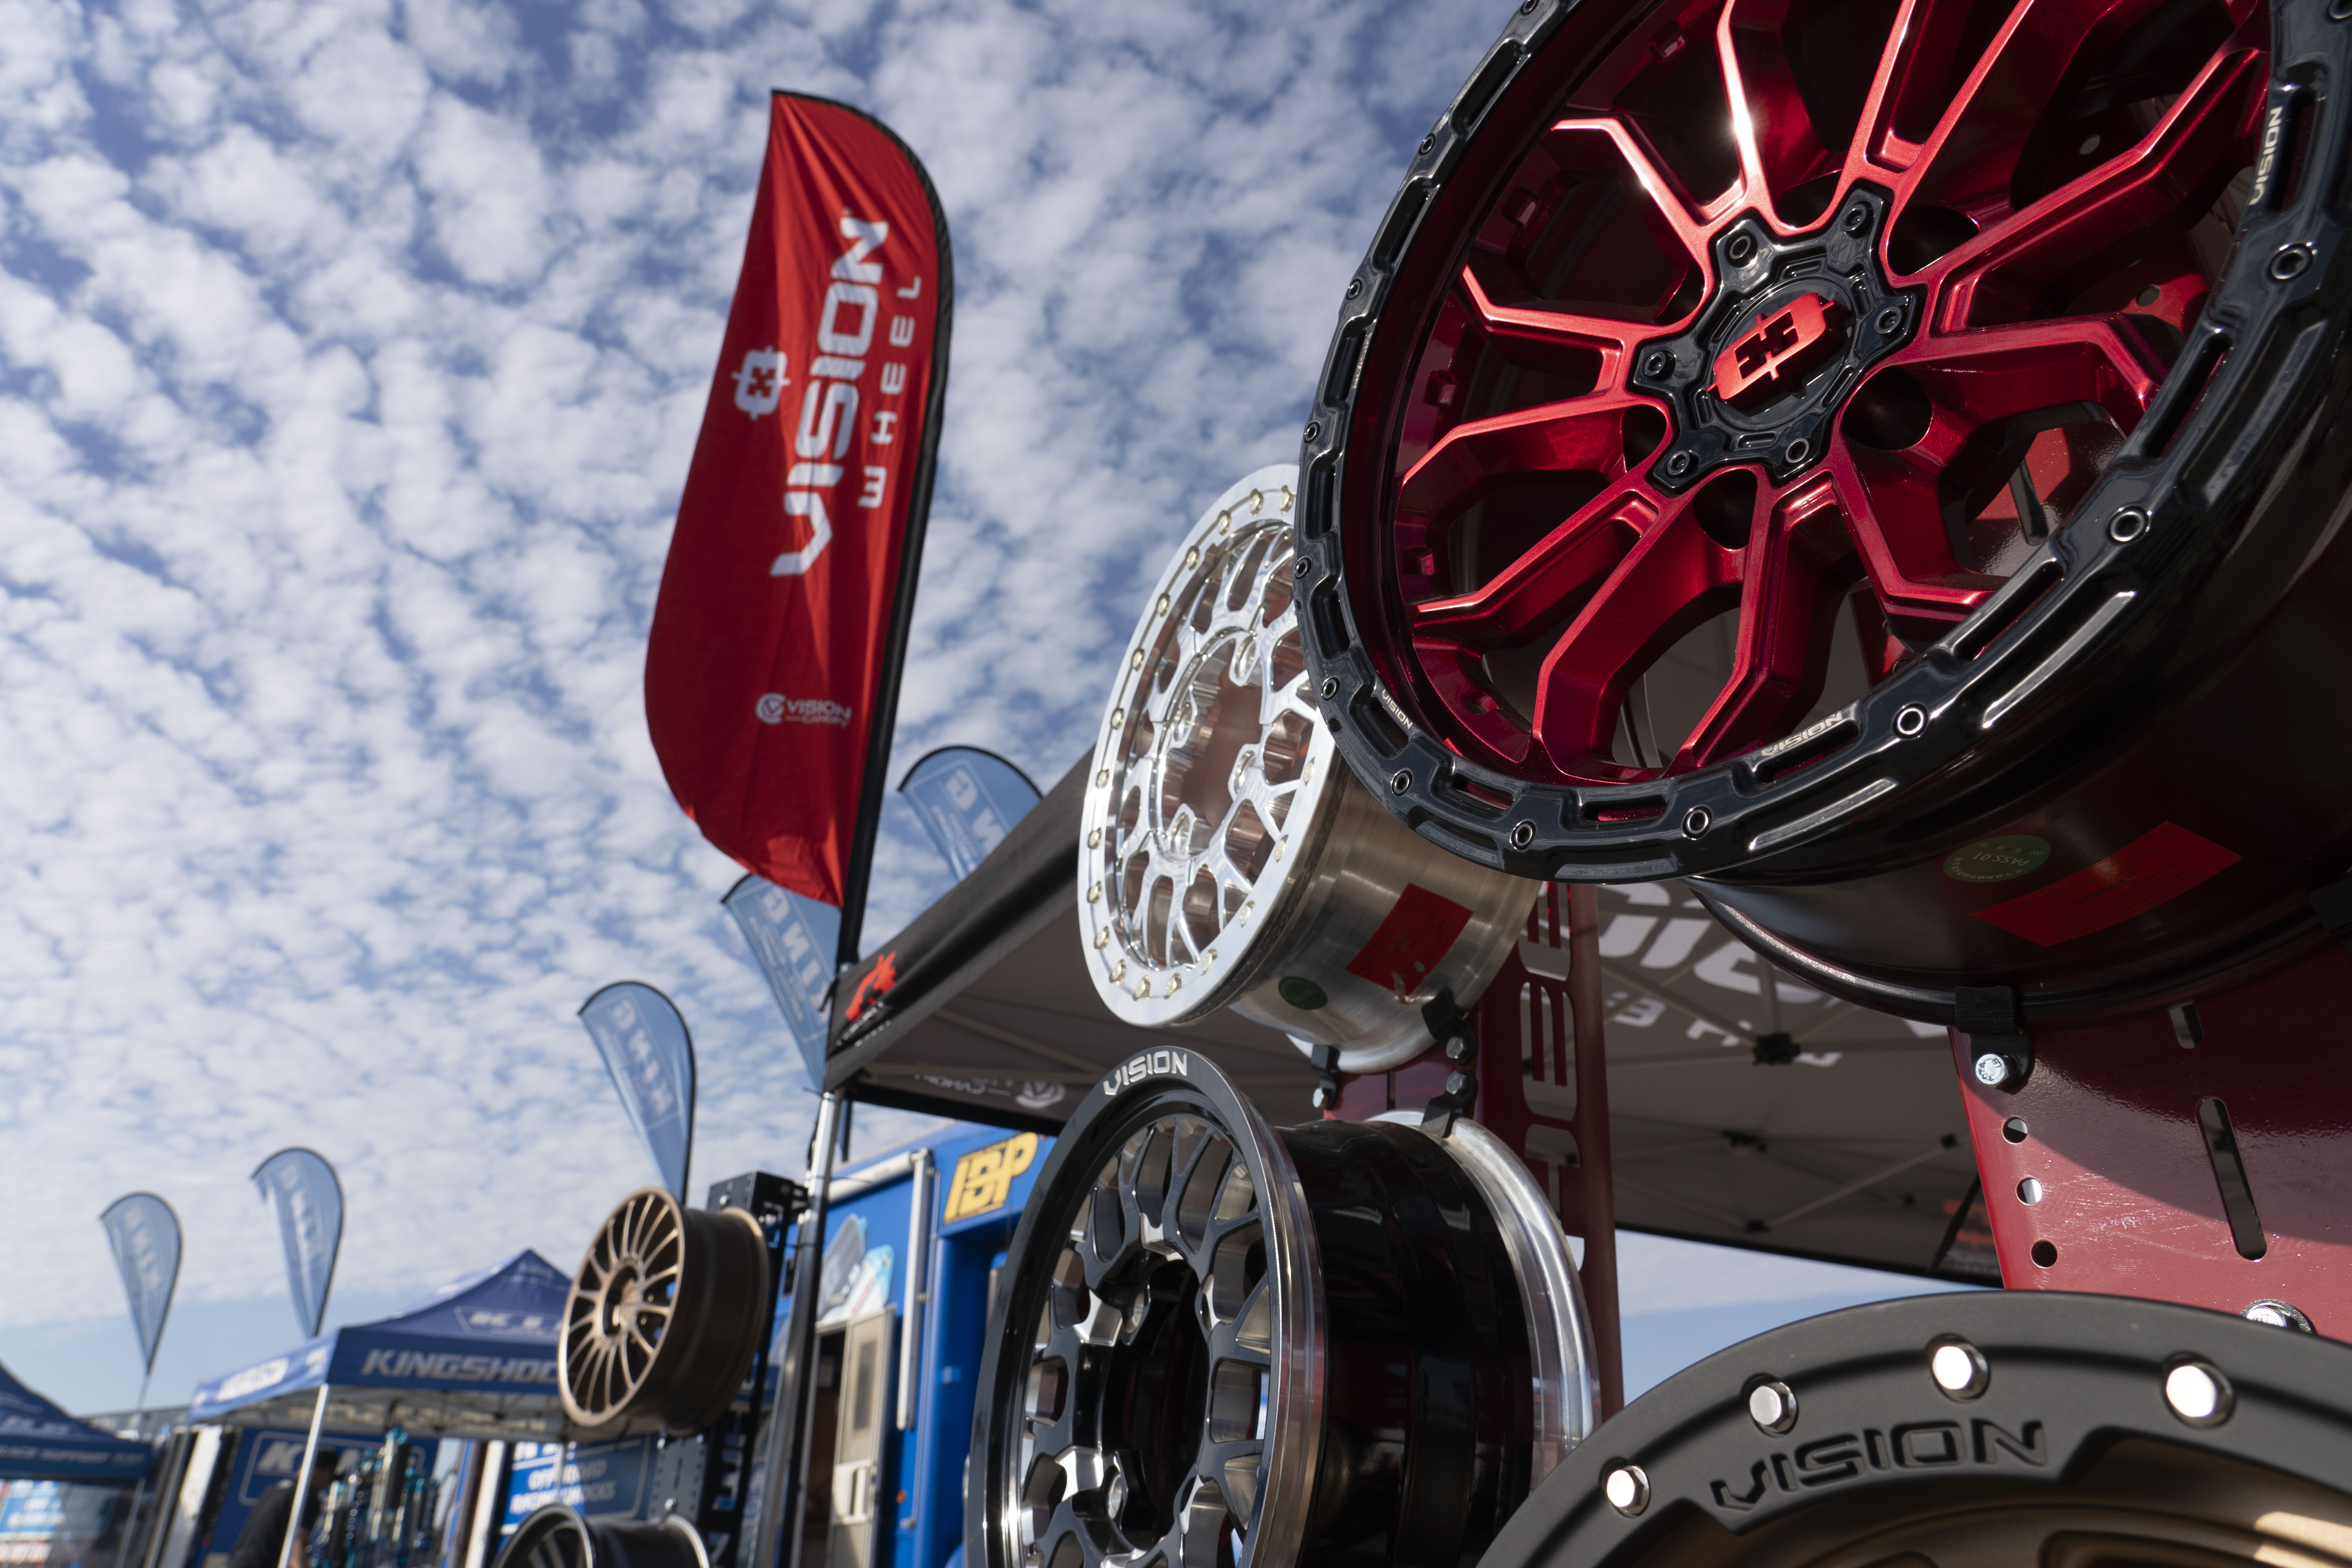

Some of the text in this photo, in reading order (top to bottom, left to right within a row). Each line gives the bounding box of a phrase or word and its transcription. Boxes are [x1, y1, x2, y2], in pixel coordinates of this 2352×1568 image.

[2249, 107, 2283, 205] VISION
[770, 217, 889, 576] VISION
[858, 275, 921, 509] WHEEL
[787, 699, 852, 721] VISION
[1381, 689, 1413, 729] VISION
[1761, 711, 1843, 757] VISION
[1972, 853, 2030, 866] PASS 01
[1102, 1050, 1188, 1096] VISION
[1709, 1418, 2047, 1512] VISION
